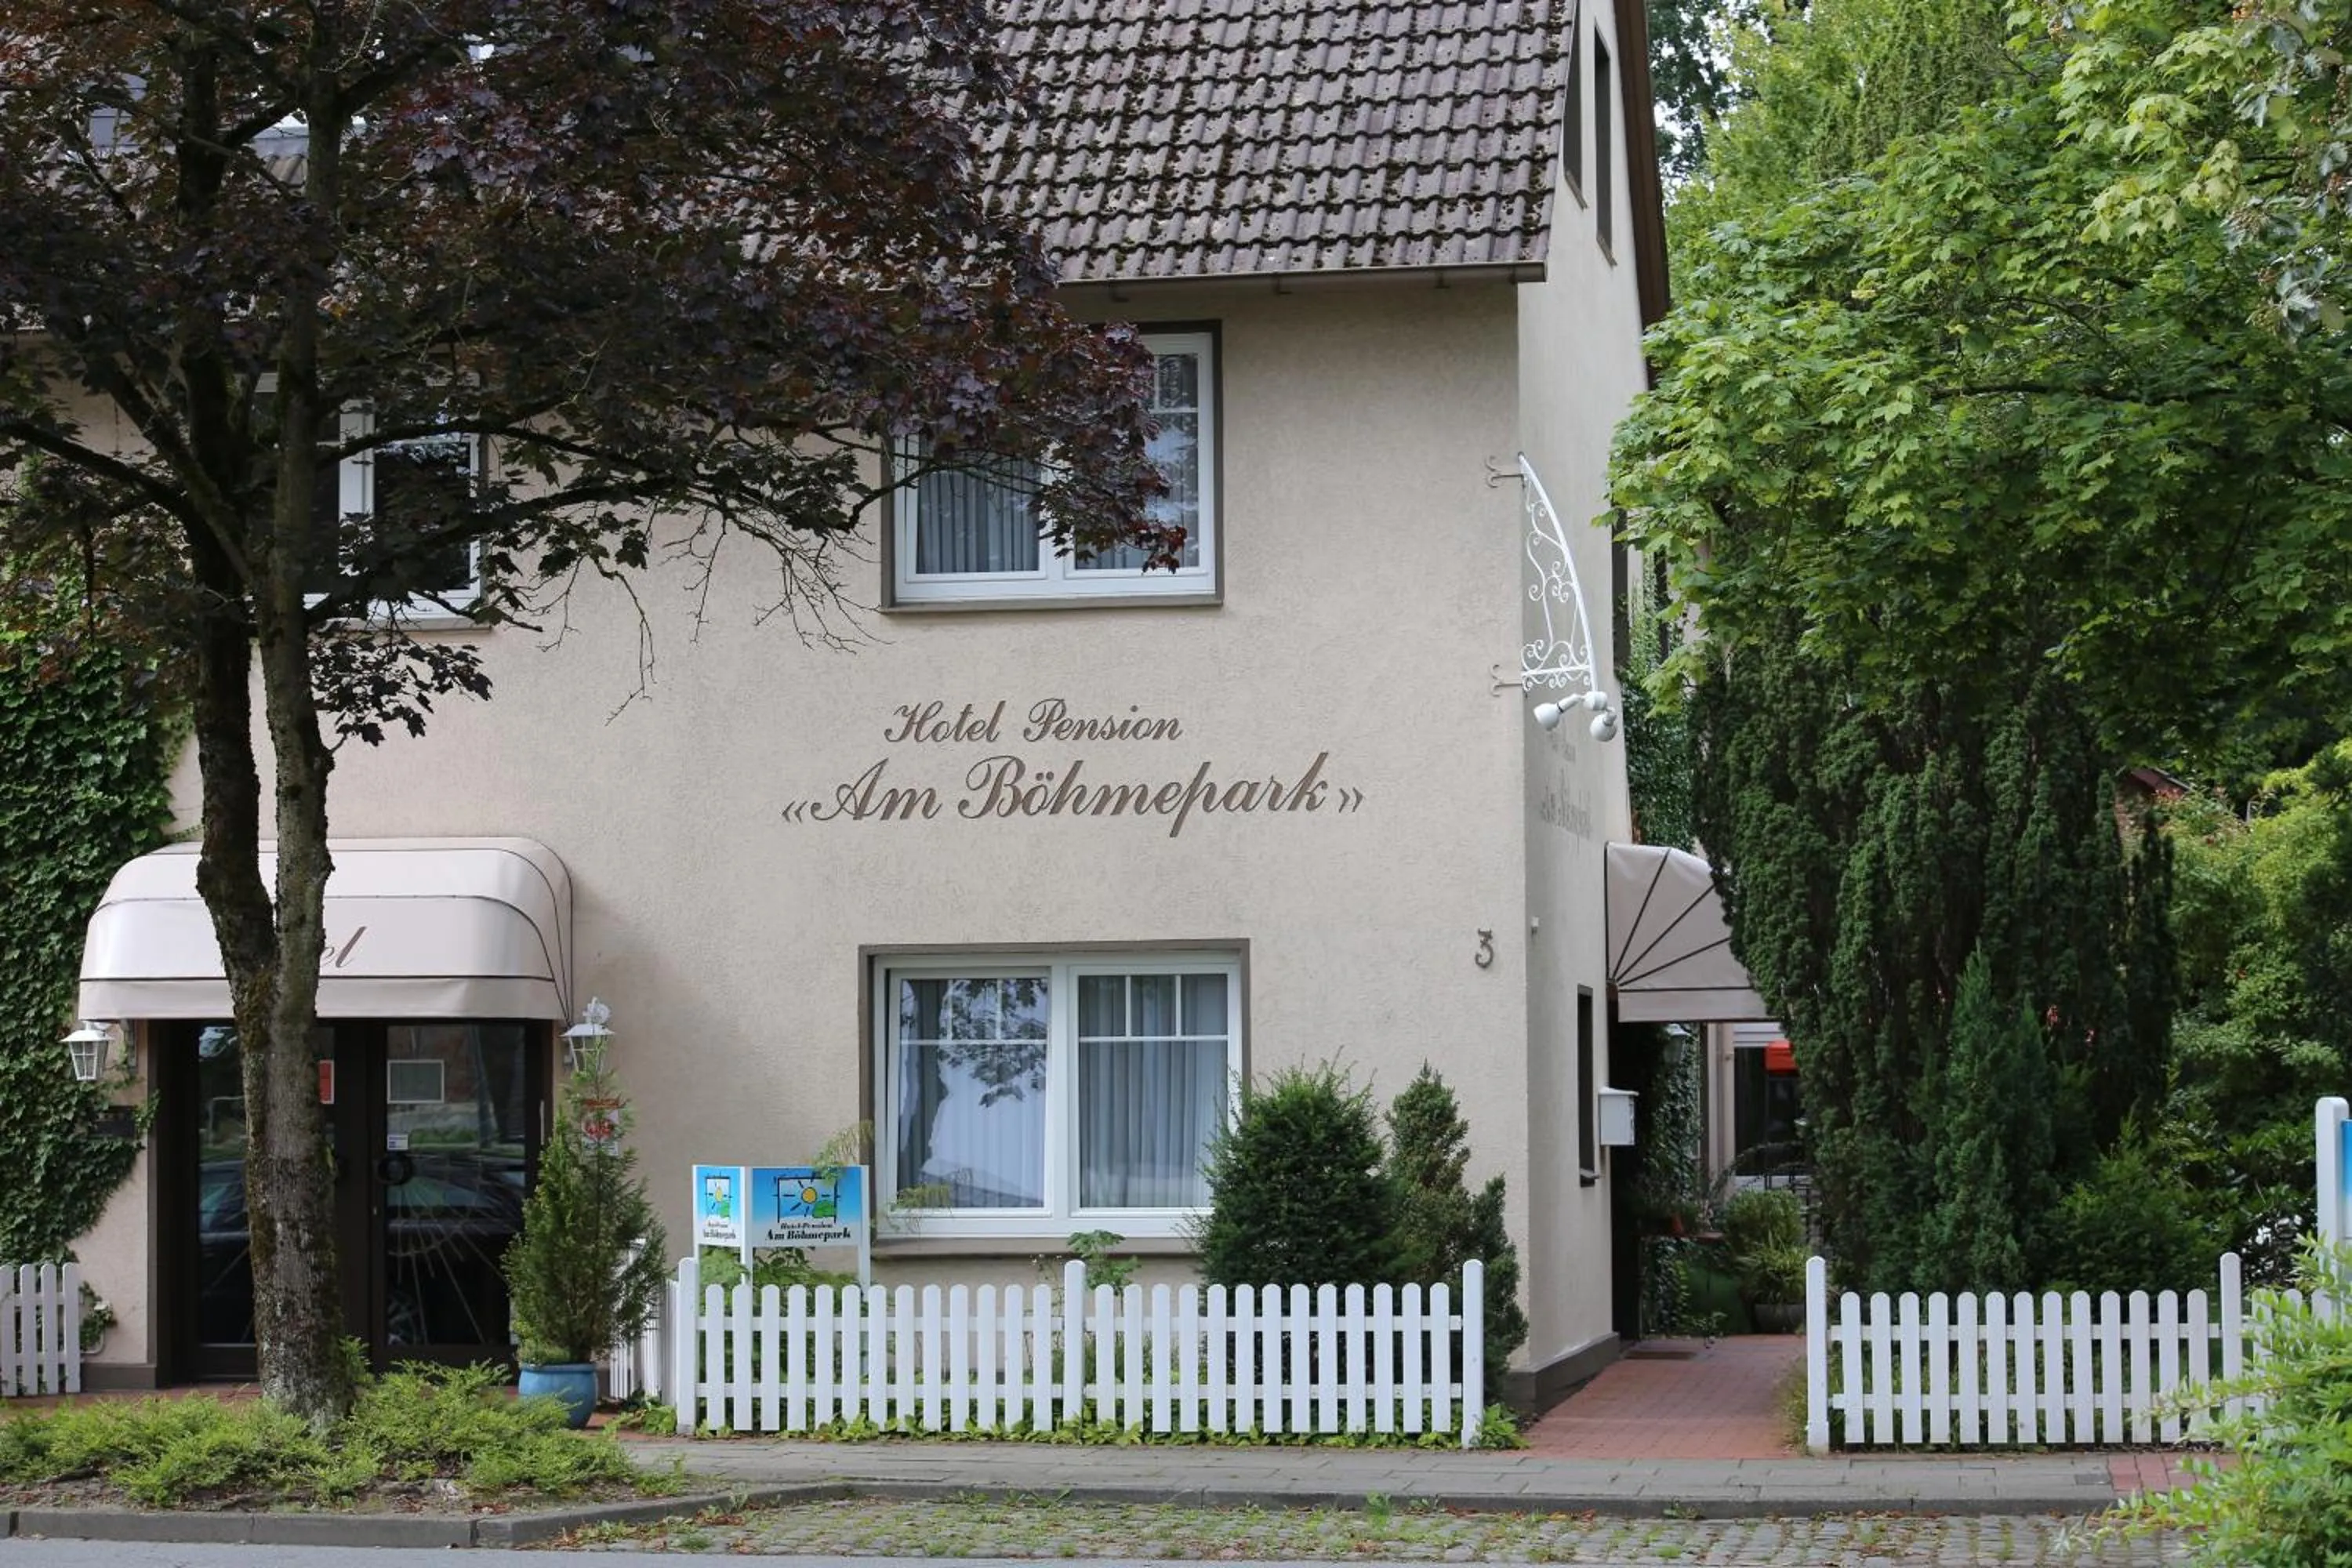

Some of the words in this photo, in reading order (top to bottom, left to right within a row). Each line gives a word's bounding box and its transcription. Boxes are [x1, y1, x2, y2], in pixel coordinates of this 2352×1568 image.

[884, 700, 1006, 743] Hotel
[1022, 698, 1183, 742] Pension
[1475, 928, 1494, 969] 3
[765, 1229, 785, 1240] Am
